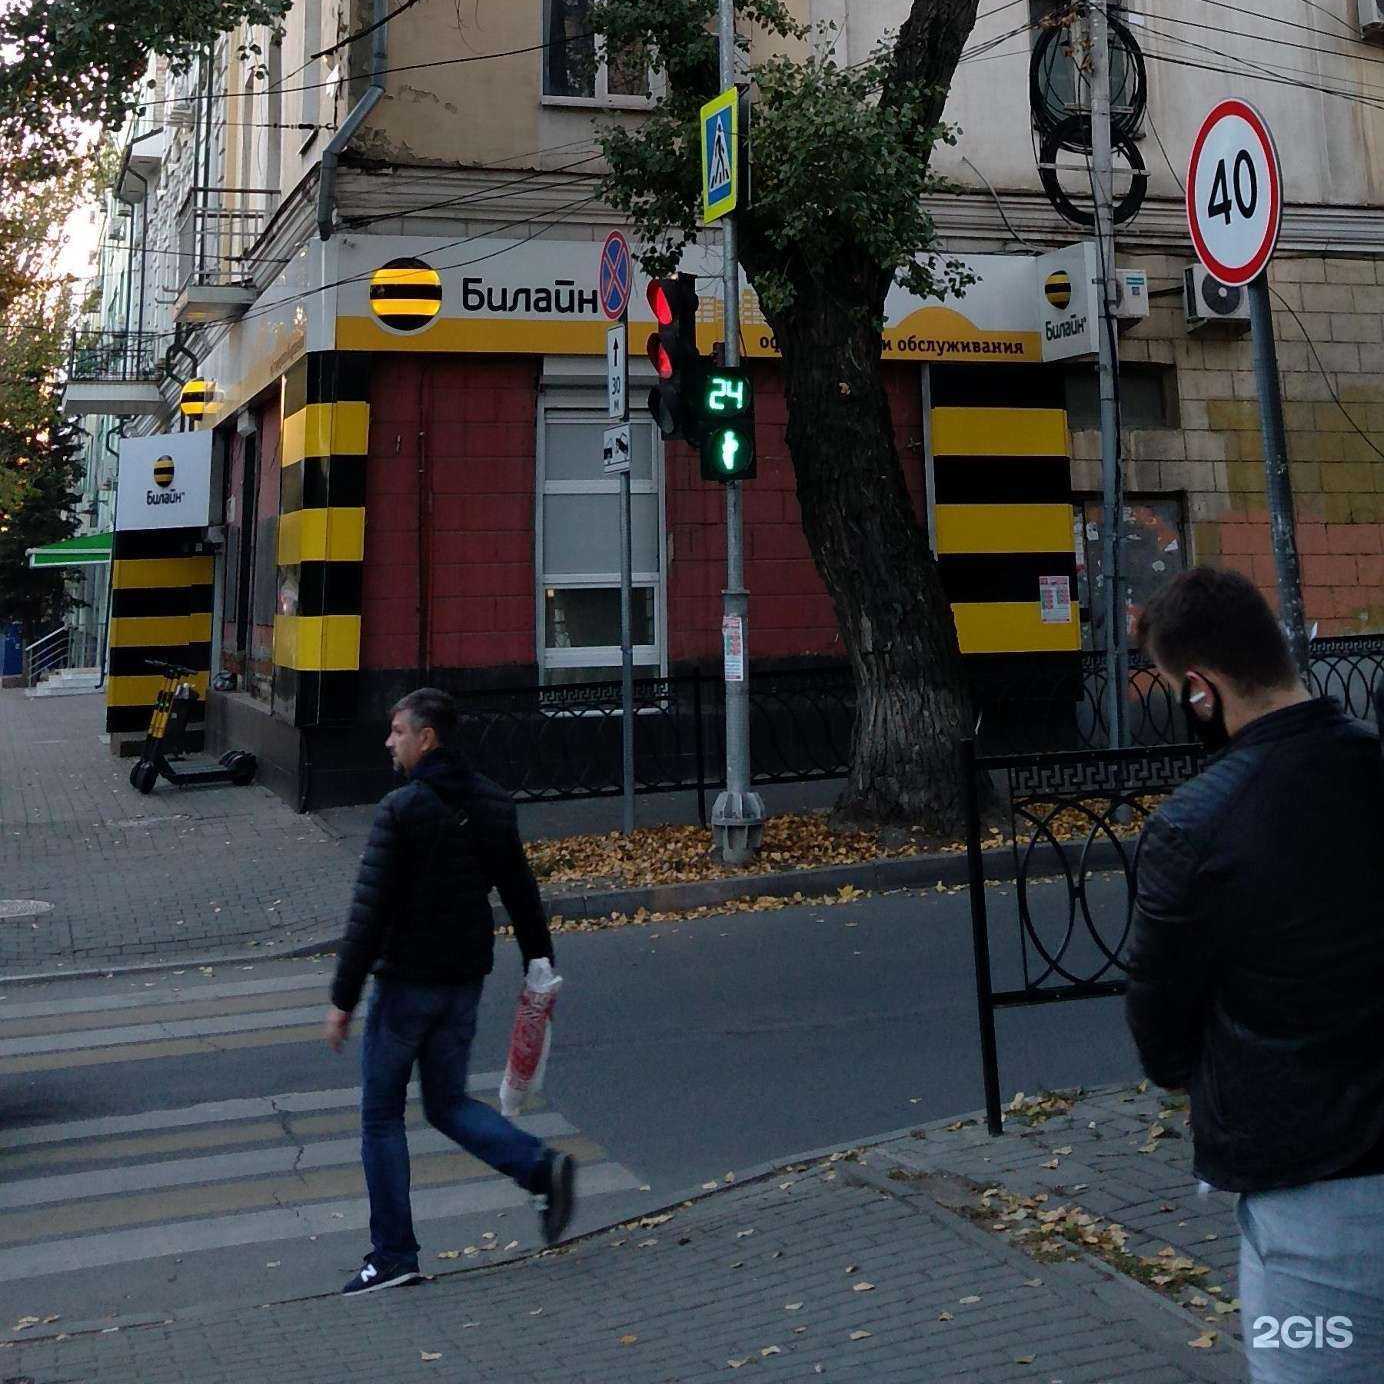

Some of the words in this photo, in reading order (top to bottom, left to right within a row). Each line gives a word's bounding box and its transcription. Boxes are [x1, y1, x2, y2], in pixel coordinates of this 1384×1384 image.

[1208, 149, 1257, 225] 40
[462, 277, 598, 313] Билайн
[1045, 314, 1086, 341] Билайн
[897, 335, 1024, 356] обслуживания
[611, 376, 621, 395] 30
[709, 378, 743, 409] 24
[146, 489, 183, 505] Билайн
[361, 1263, 378, 1283] N
